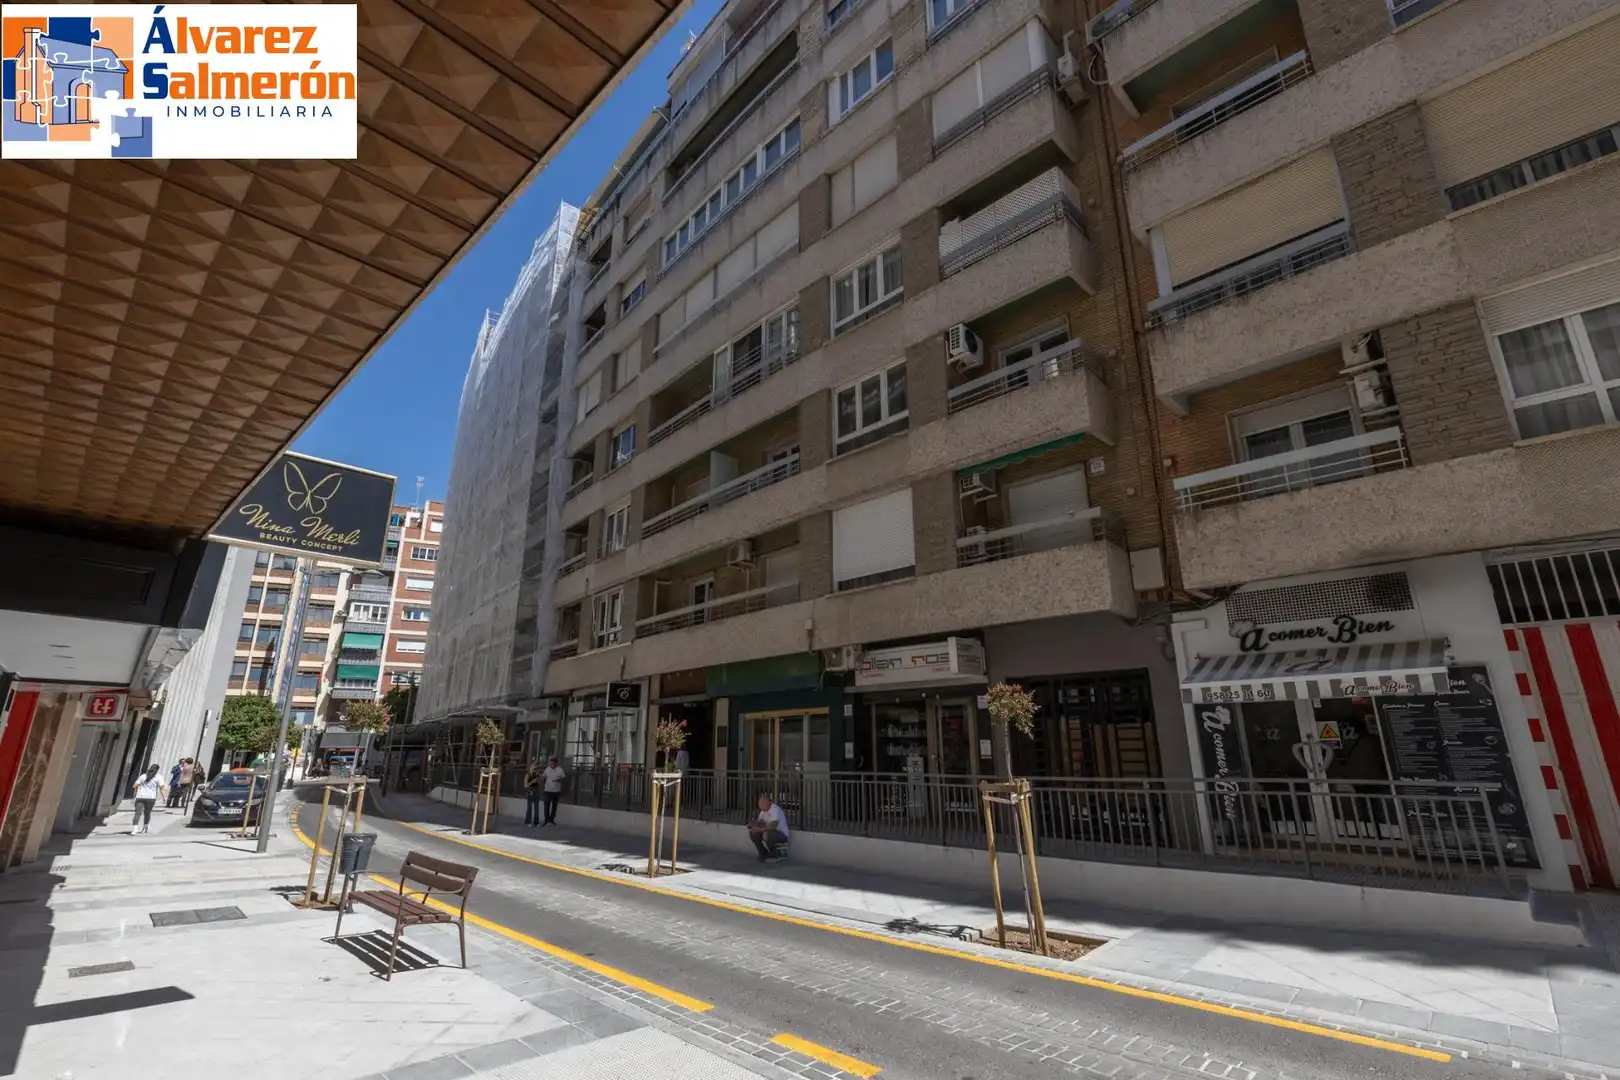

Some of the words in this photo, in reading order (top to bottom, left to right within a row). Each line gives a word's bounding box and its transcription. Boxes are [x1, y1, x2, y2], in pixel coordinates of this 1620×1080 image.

[239, 503, 296, 534] Nina
[301, 516, 361, 546] Merli
[259, 532, 298, 544] BEAUTY
[301, 540, 343, 552] CONCEPT
[1268, 627, 1329, 642] comer
[1328, 614, 1394, 643] Bien
[1206, 690, 1226, 700] 958
[1226, 690, 1240, 700] 25
[1243, 688, 1255, 699] 11
[1257, 688, 1271, 698] 60
[1385, 680, 1414, 693] Bien
